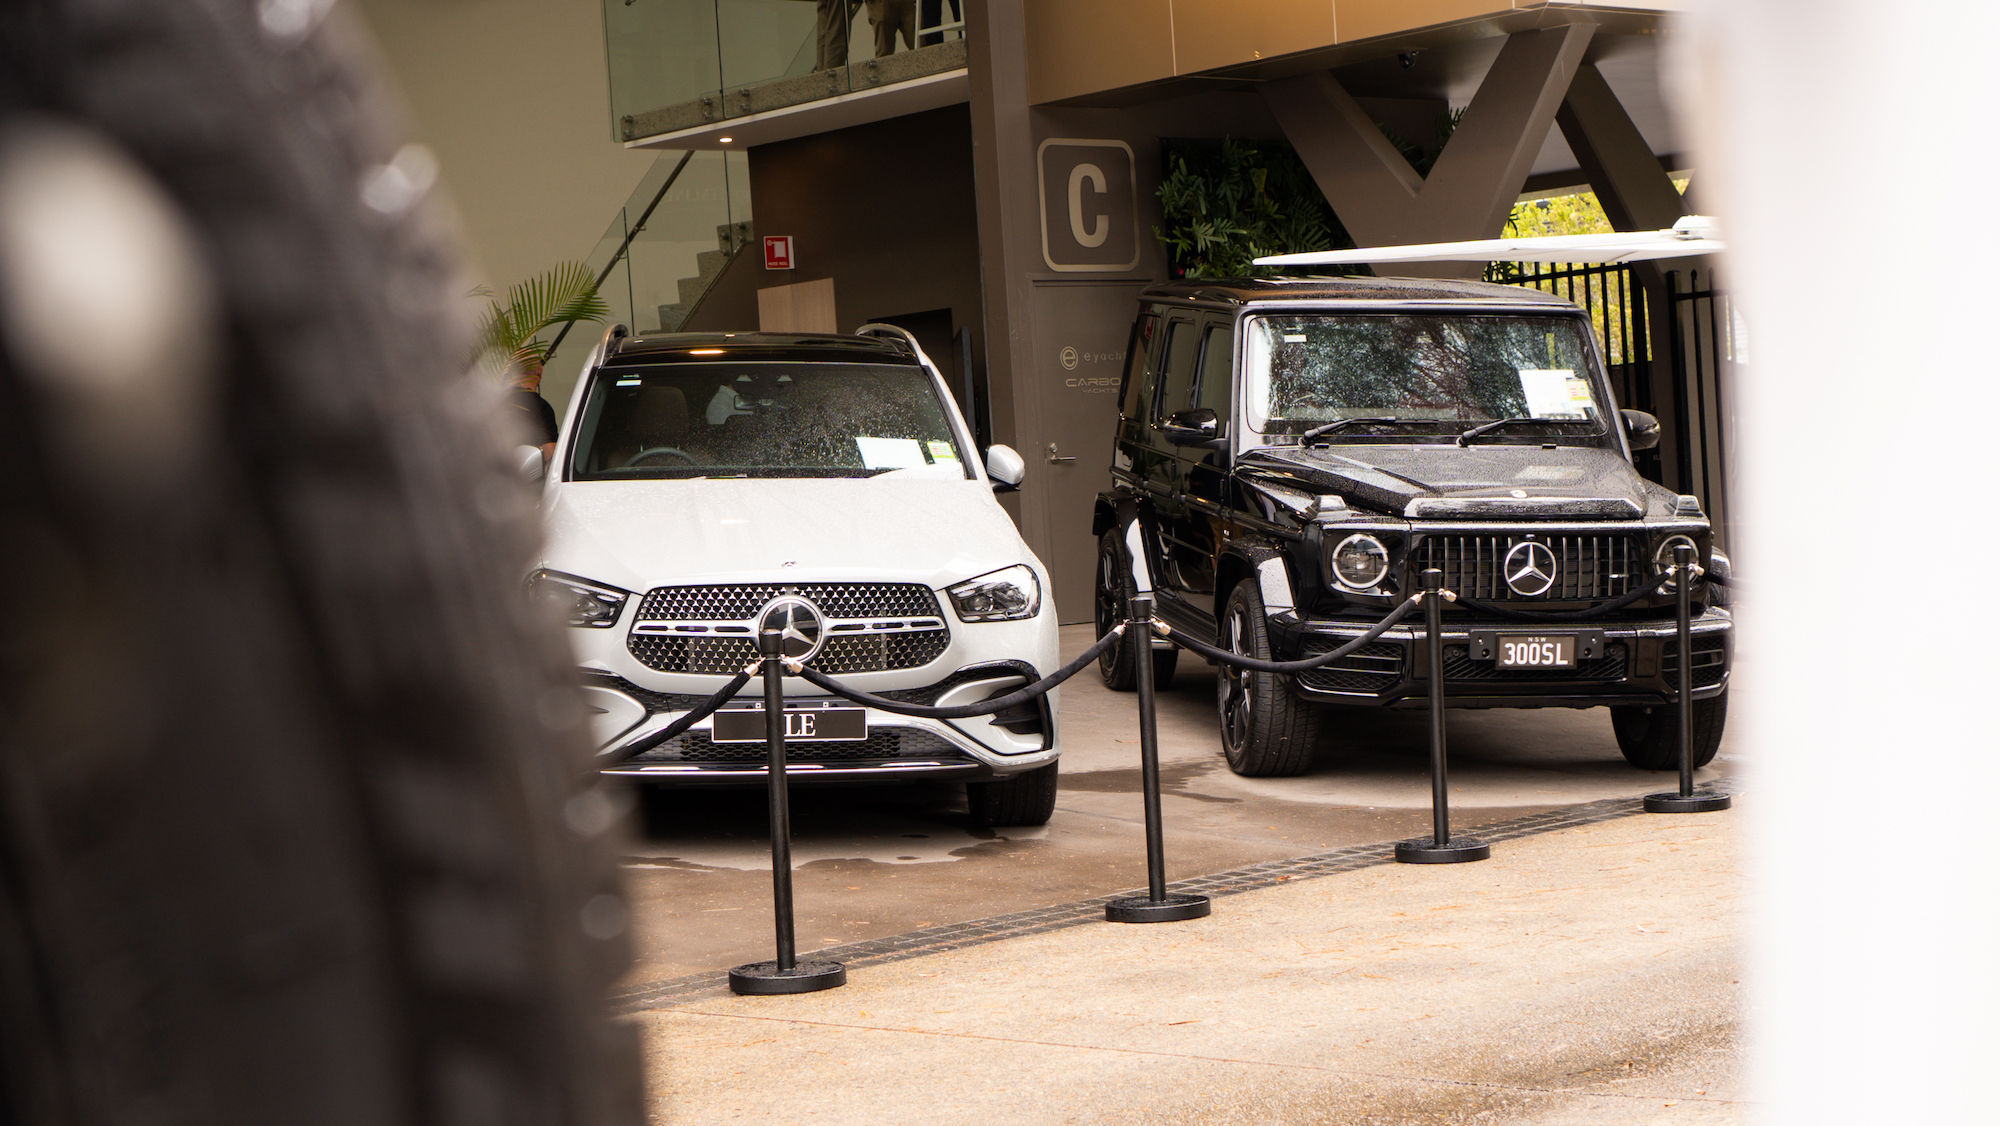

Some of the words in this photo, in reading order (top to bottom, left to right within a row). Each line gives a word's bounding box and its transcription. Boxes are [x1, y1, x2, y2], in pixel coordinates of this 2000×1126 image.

[1067, 162, 1110, 249] C
[1065, 377, 1121, 388] CARBO
[1503, 642, 1569, 665] 300SL
[783, 713, 816, 737] LE
